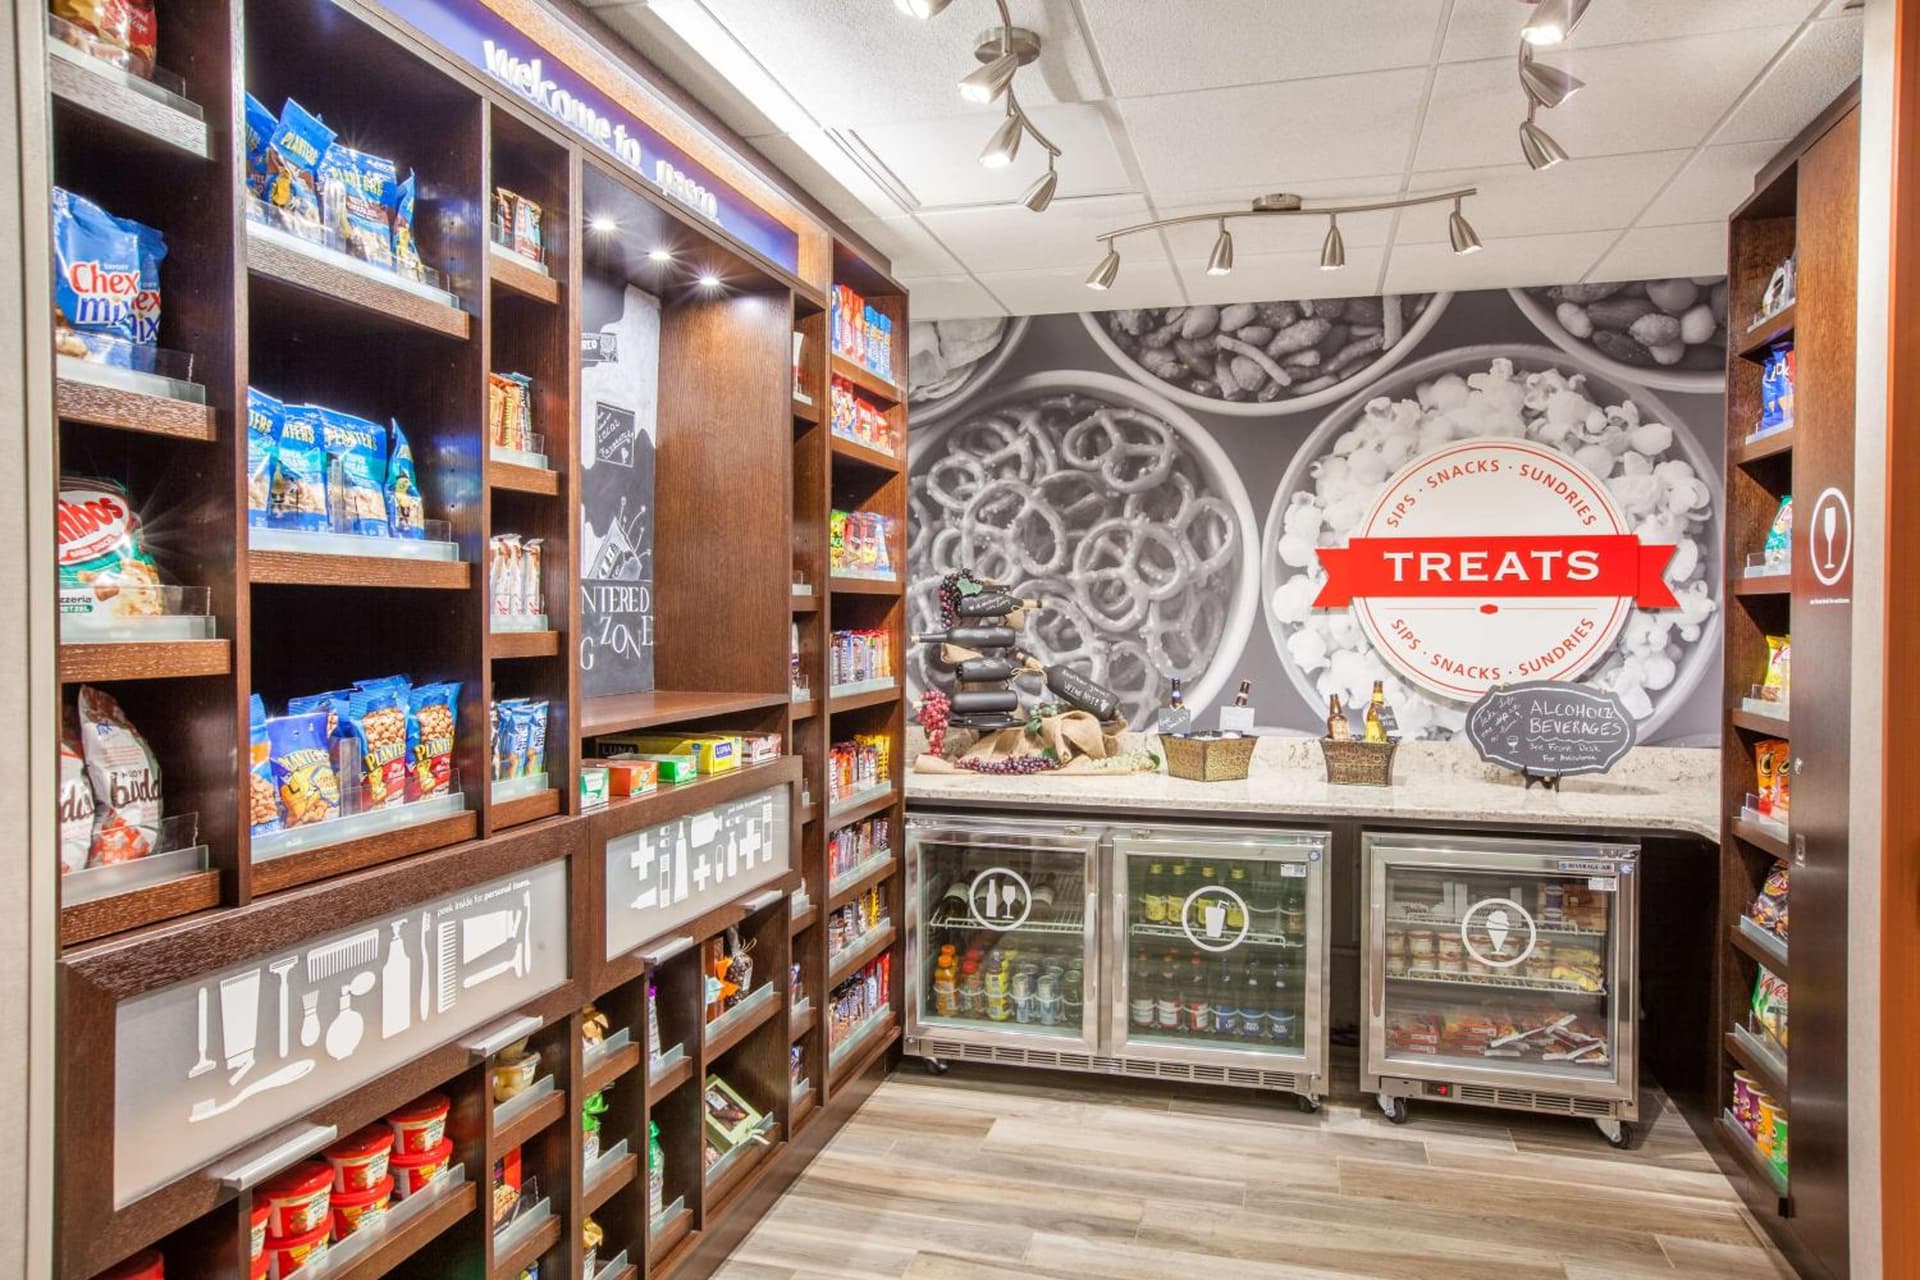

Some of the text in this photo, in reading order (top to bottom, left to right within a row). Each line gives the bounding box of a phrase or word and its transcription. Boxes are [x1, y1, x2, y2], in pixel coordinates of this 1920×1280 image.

[614, 125, 642, 168] to
[70, 262, 140, 295] Chex
[1386, 459, 1597, 528] SIPS SNACKS SUNDRIES
[1383, 550, 1600, 582] TREATS
[600, 615, 653, 660] ZONE
[1391, 617, 1595, 680] SIPS SNACKS SUNDRIES
[1530, 717, 1622, 736] BEVERAGES
